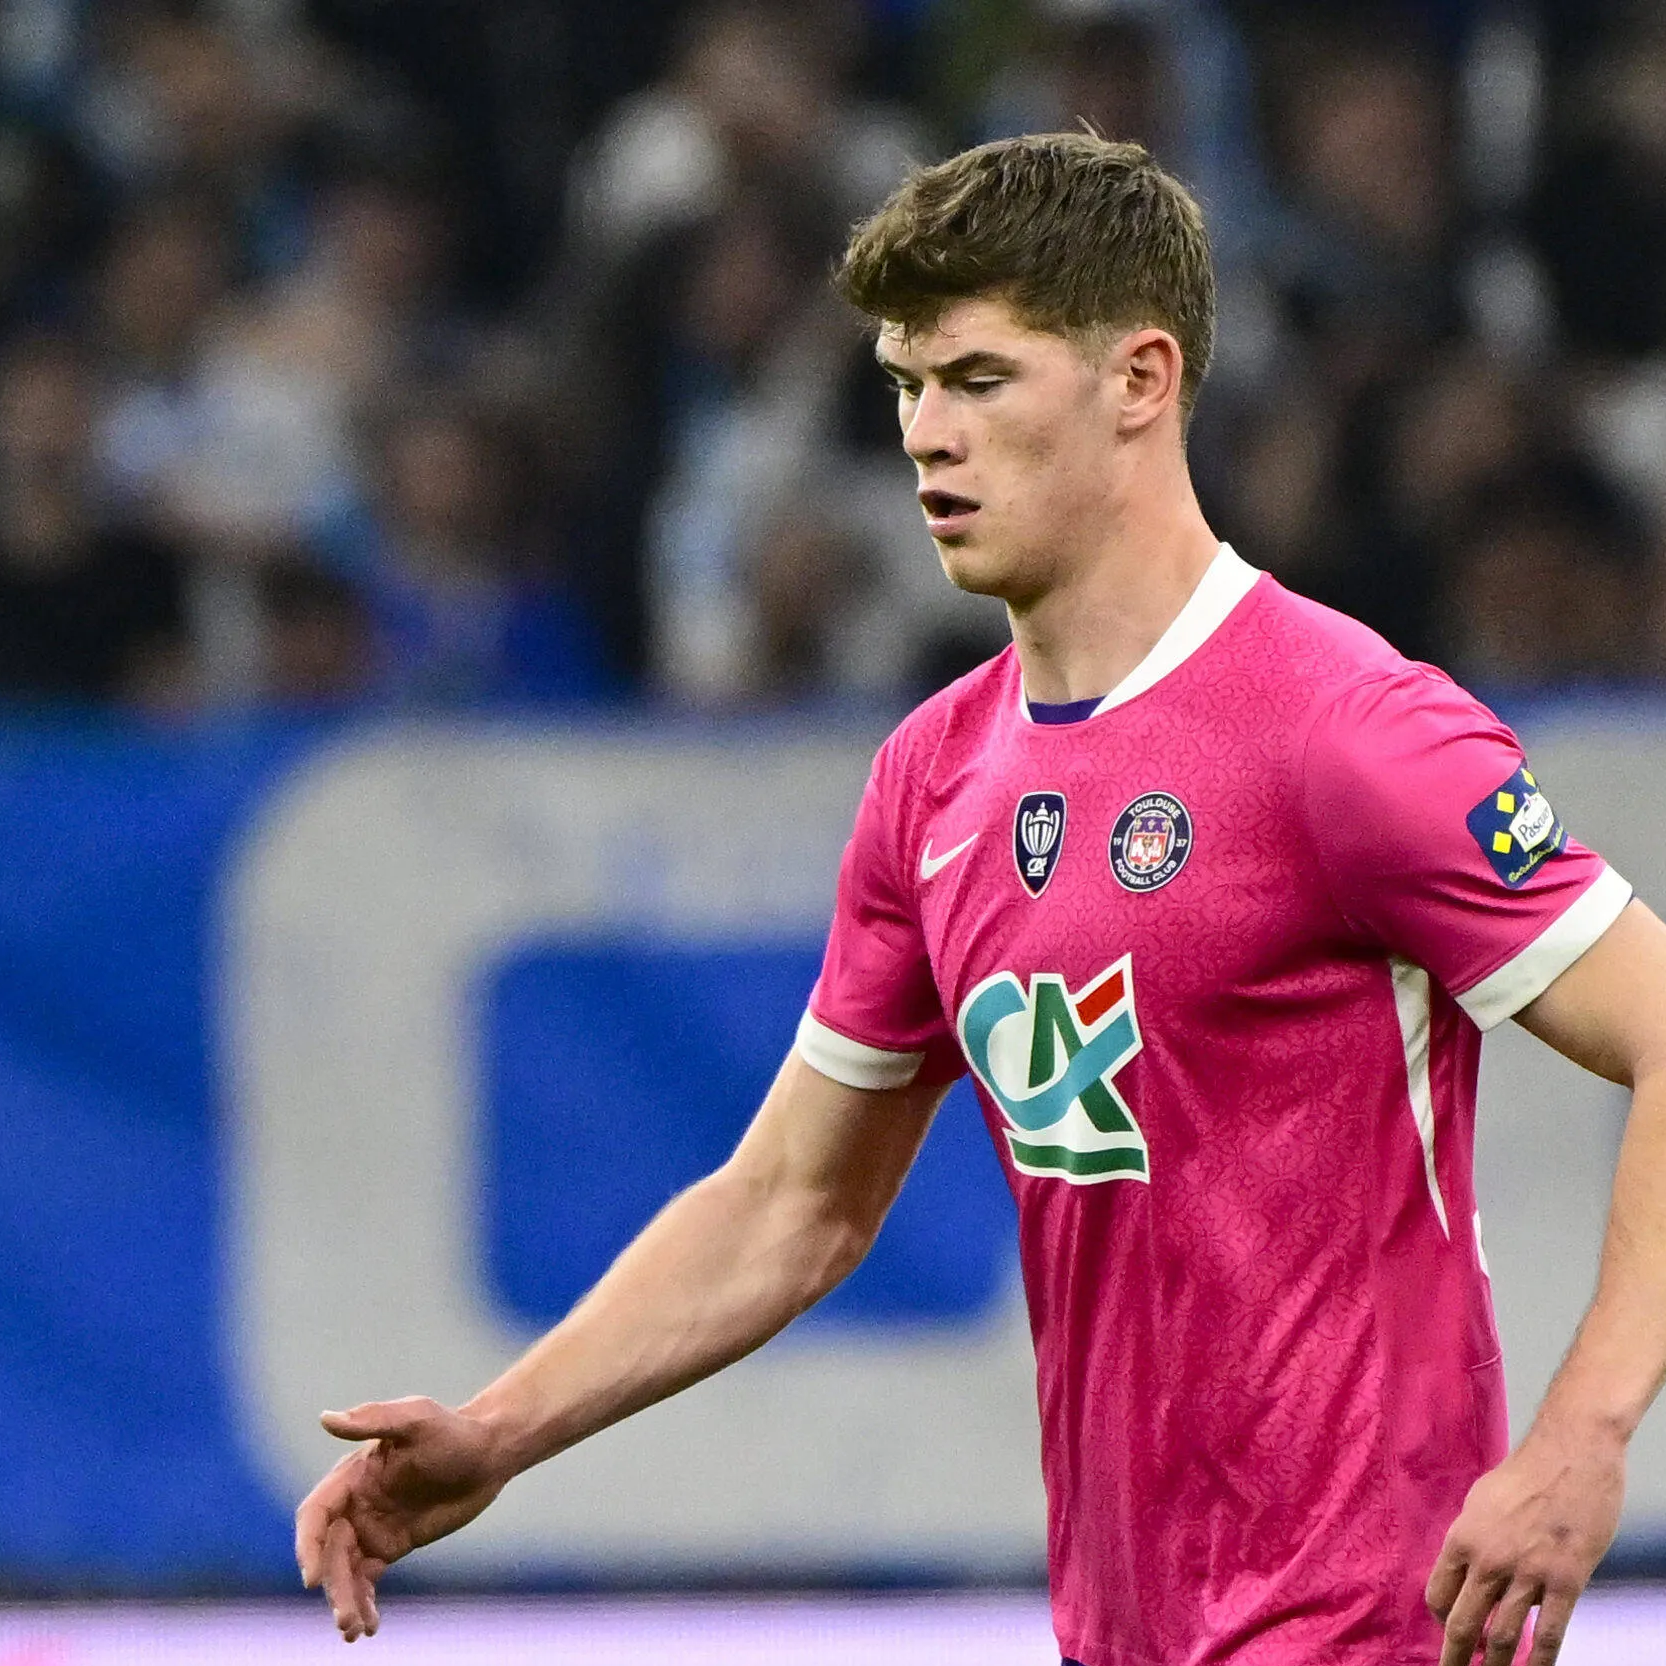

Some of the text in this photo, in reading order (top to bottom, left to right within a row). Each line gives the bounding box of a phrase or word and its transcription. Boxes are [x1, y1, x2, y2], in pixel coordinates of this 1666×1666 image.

[1128, 797, 1182, 820] TOULOUSE
[1113, 837, 1123, 847] 19
[1175, 837, 1188, 848] 37
[1113, 858, 1177, 885] FOOTBALL CLUB
